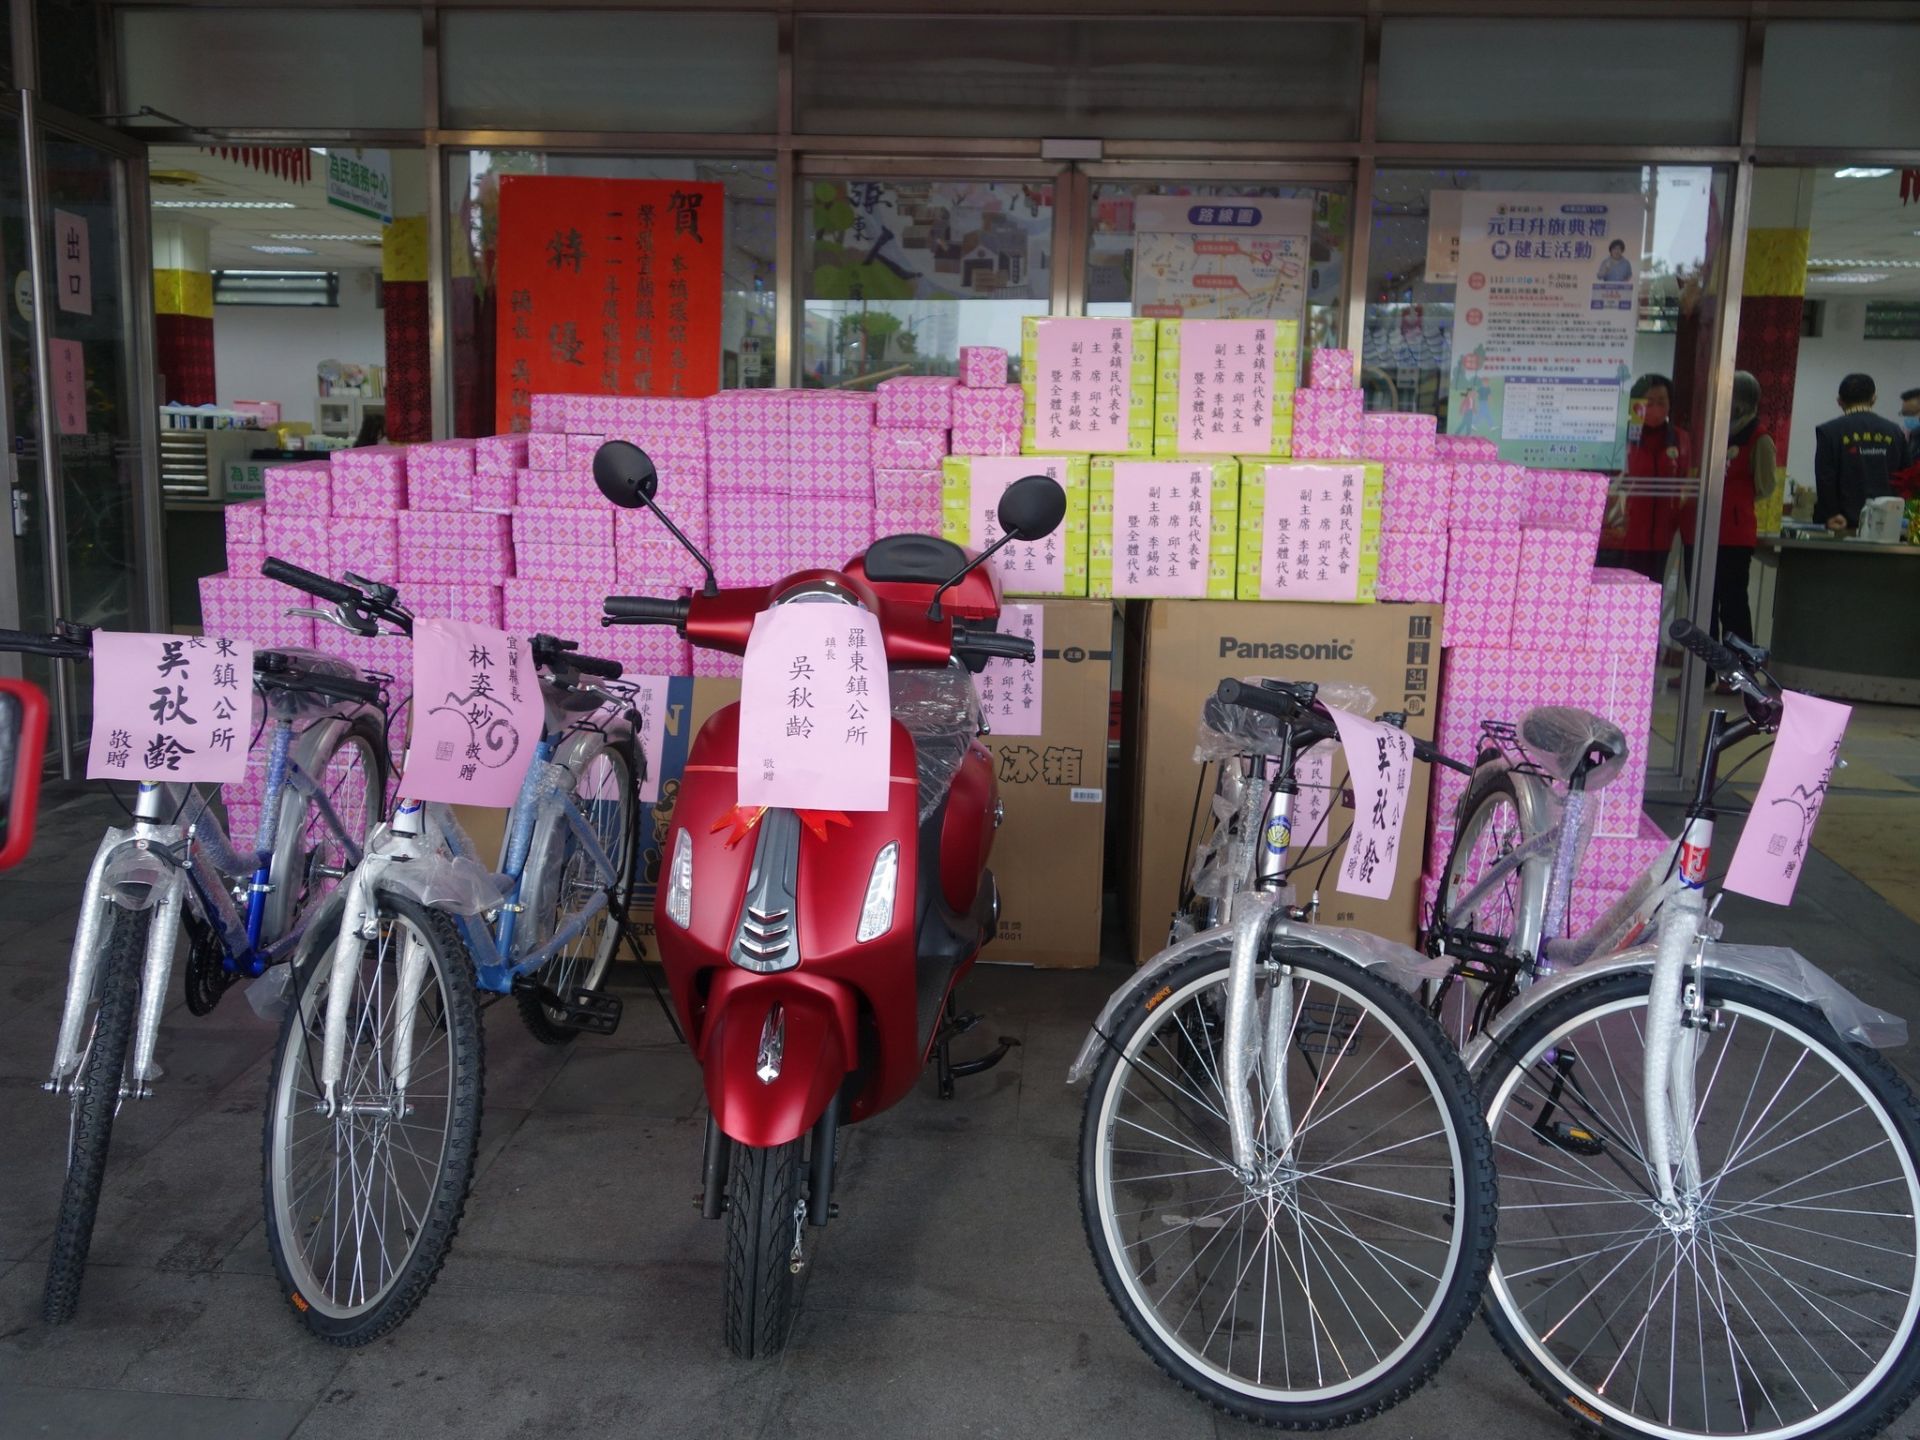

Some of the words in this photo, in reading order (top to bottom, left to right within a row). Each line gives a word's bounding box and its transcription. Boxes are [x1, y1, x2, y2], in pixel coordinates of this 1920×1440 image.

[667, 190, 704, 244] 賀
[1197, 207, 1255, 225] 路線圖
[1488, 217, 1607, 237] 元旦升旗典禮
[1514, 240, 1592, 260] 健走活動
[66, 226, 81, 296] 出口
[545, 228, 589, 366] 特優
[1050, 370, 1063, 439] 暨全體代表
[1110, 327, 1123, 425] 羅東鎮民代表會
[1192, 372, 1206, 441] 暨全體代表
[1252, 328, 1266, 427] 羅東鎮民代表會
[1126, 515, 1141, 585] 暨全體代表
[1187, 471, 1202, 571] 羅東鎮民代表會
[1274, 517, 1291, 589] 暨全體代表
[1338, 474, 1354, 575] 羅東鎮民代表會
[506, 635, 523, 703] 宜蘭縣長
[825, 636, 836, 661] 鎮長
[1219, 637, 1354, 661] Panasonic
[1409, 670, 1424, 681] 34
[144, 641, 198, 771] 吳秋齡
[467, 644, 495, 730] 林姿妙
[785, 655, 815, 740] 吳秋齡
[844, 627, 870, 747] 羅東鎮公所
[106, 730, 132, 769] 敬贈
[457, 742, 482, 781] 敬贈
[763, 758, 775, 781] 敬贈
[1360, 737, 1391, 885] 吳秋齡
